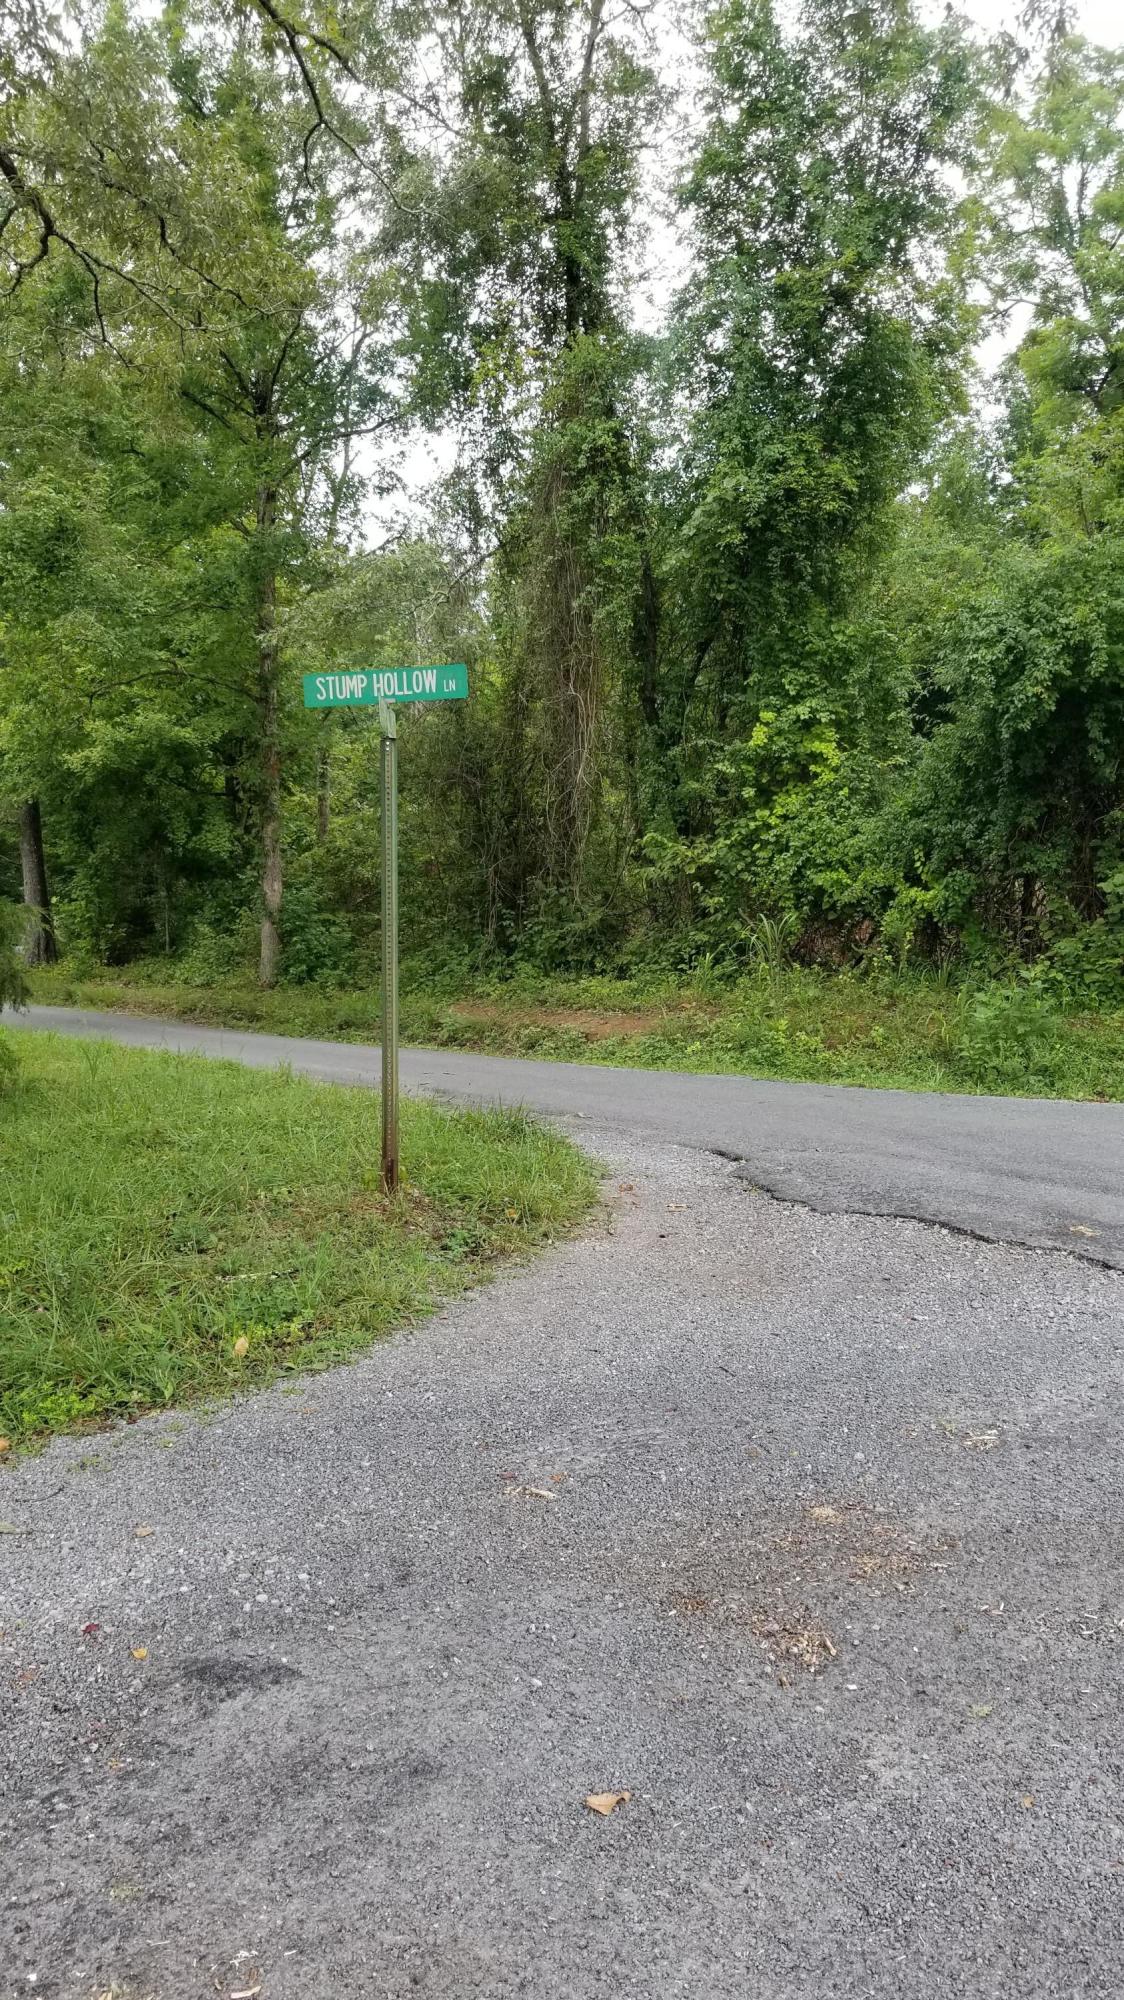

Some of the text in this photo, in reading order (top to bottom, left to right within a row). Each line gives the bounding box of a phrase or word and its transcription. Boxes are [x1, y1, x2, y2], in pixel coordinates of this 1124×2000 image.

[315, 669, 456, 700] STUMP HOLLOW LN
